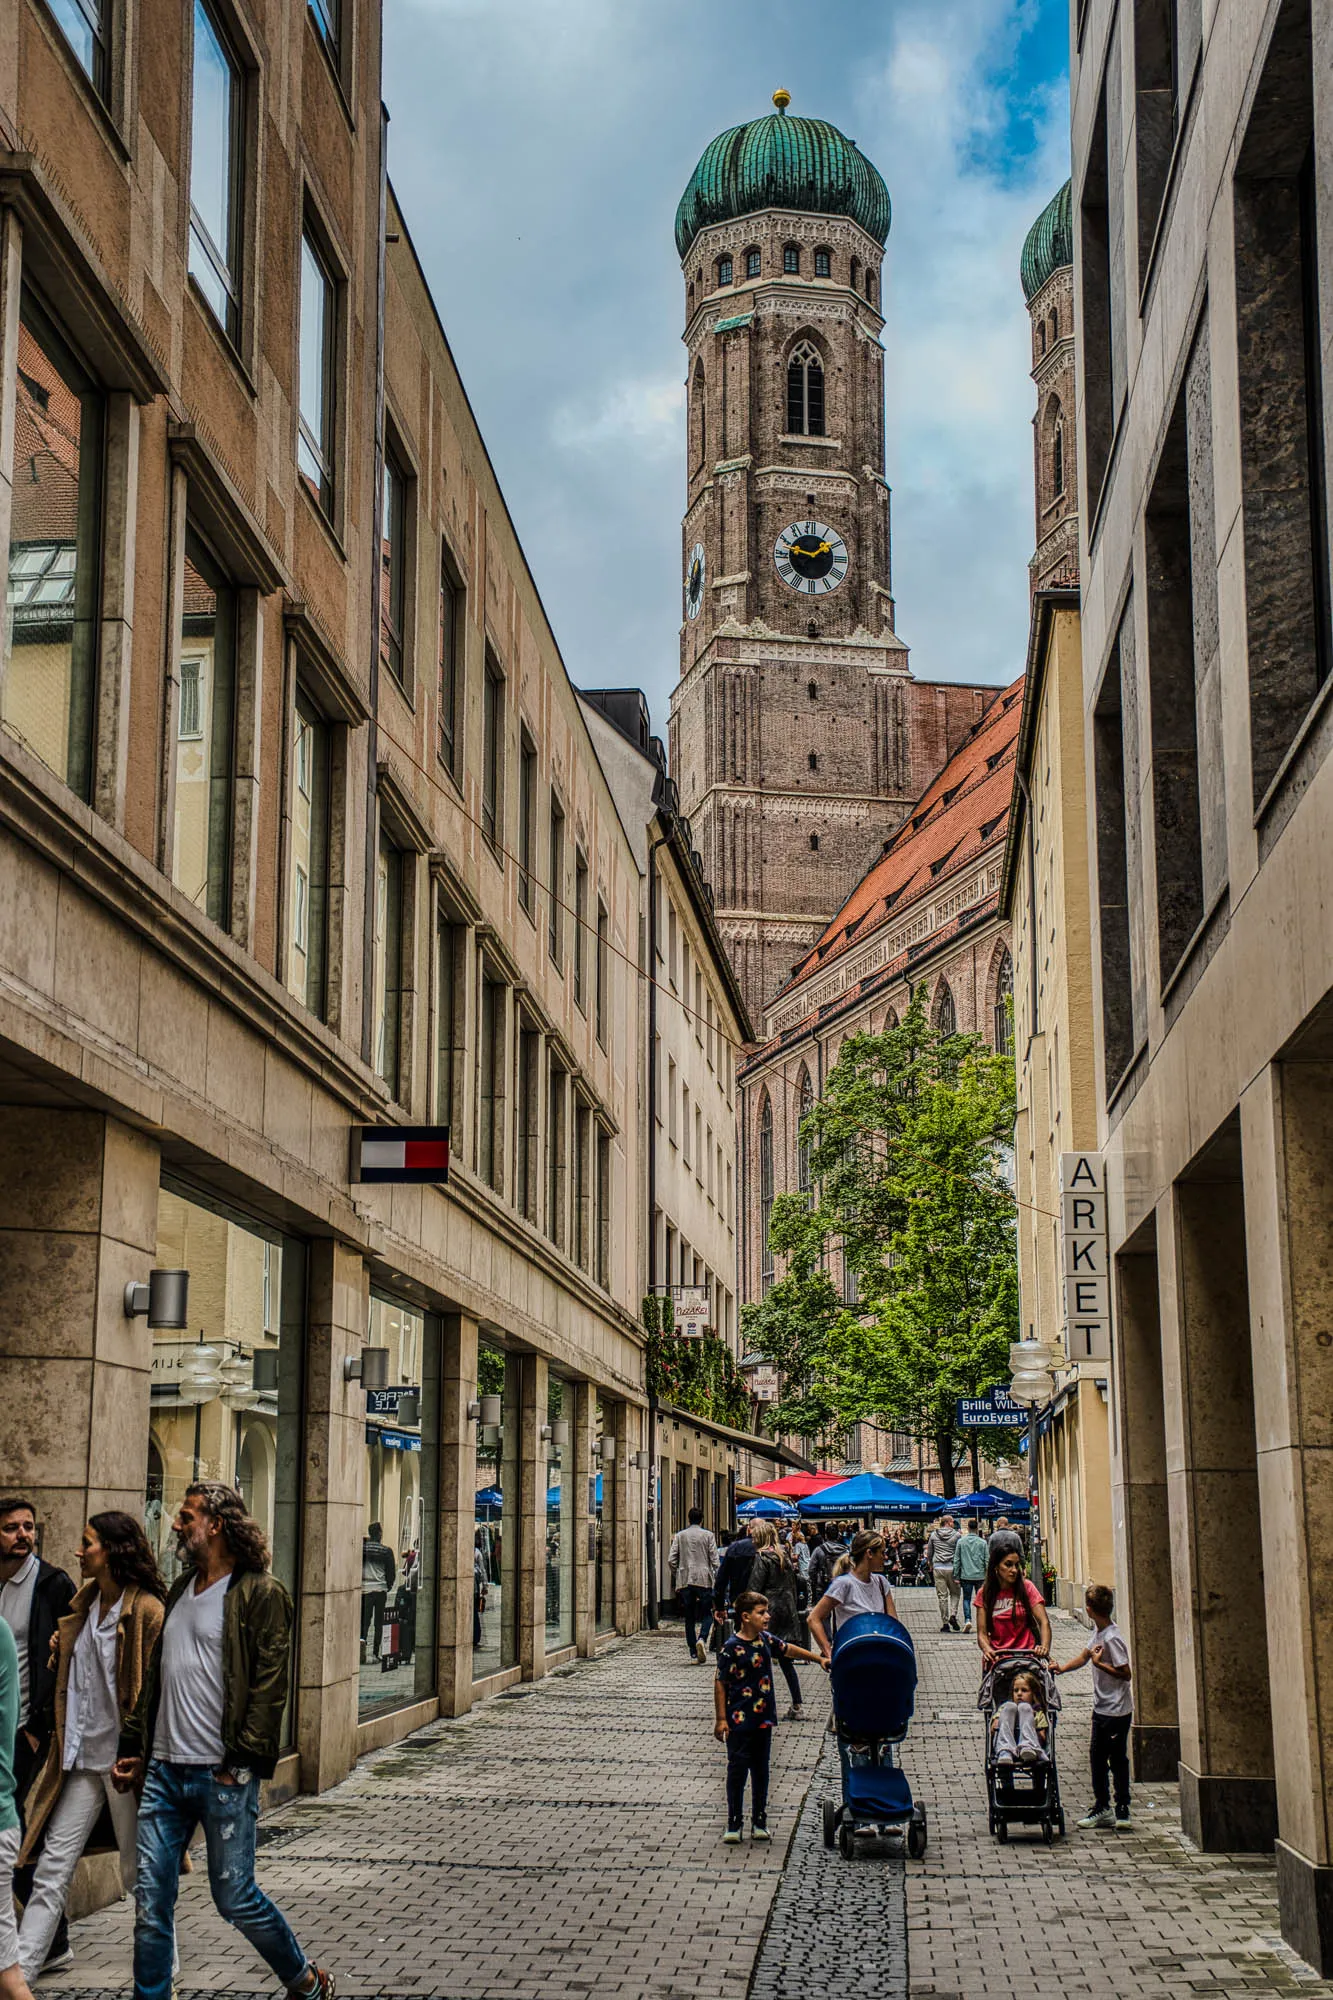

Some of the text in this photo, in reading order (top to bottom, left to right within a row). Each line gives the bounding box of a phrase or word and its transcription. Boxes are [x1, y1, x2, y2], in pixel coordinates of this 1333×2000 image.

[1070, 1157, 1101, 1356] ARKET
[962, 1400, 992, 1410] Brille
[995, 1400, 1025, 1409] WILL
